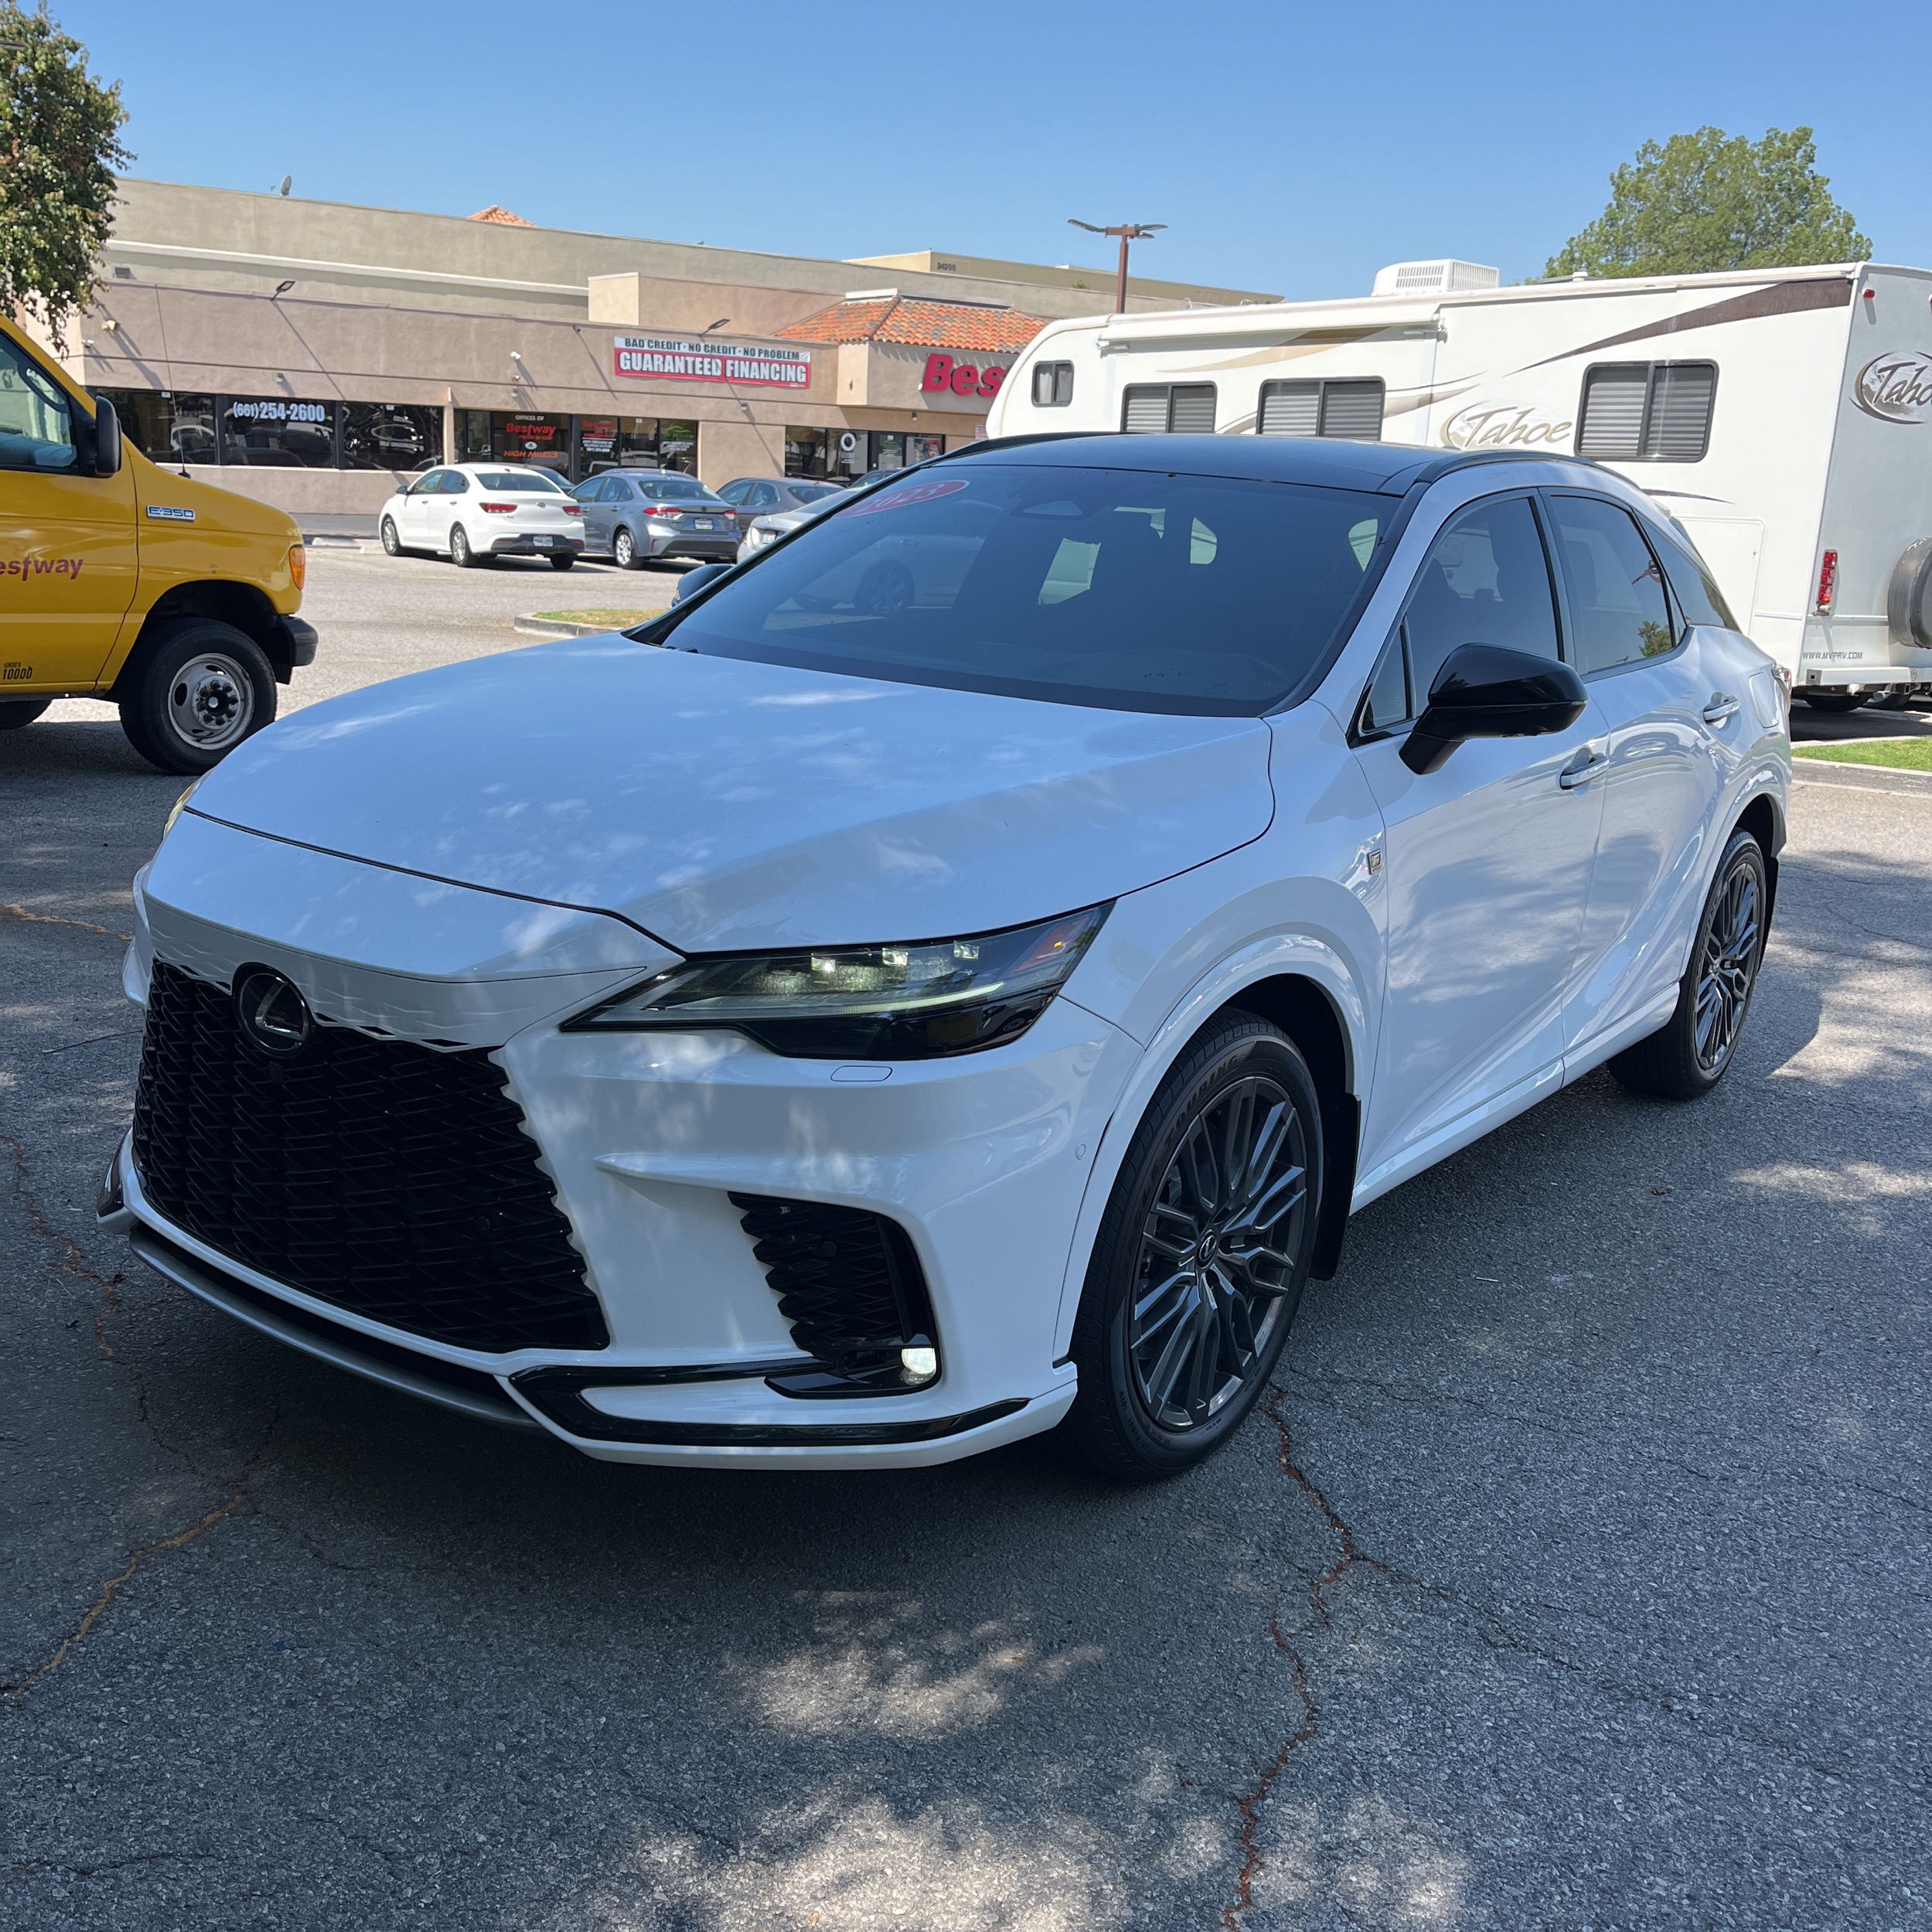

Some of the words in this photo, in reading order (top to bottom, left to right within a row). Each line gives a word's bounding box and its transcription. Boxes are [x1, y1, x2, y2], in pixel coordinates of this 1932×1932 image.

[625, 338, 645, 348] BAD
[647, 339, 681, 351] CREDIT
[688, 342, 701, 353] NO
[704, 344, 737, 355] CREDIT
[744, 347, 756, 357] NO
[758, 349, 799, 360] PROBLEM
[619, 351, 722, 377] GUARANTEED
[725, 359, 806, 383] FINANCING
[922, 353, 1007, 397] Bes
[233, 401, 259, 418] (661)
[259, 402, 325, 422] 254-2600
[1464, 406, 1573, 448] Tahoe
[506, 423, 556, 436] Bestway
[1164, 1054, 1239, 1147] TOURING
